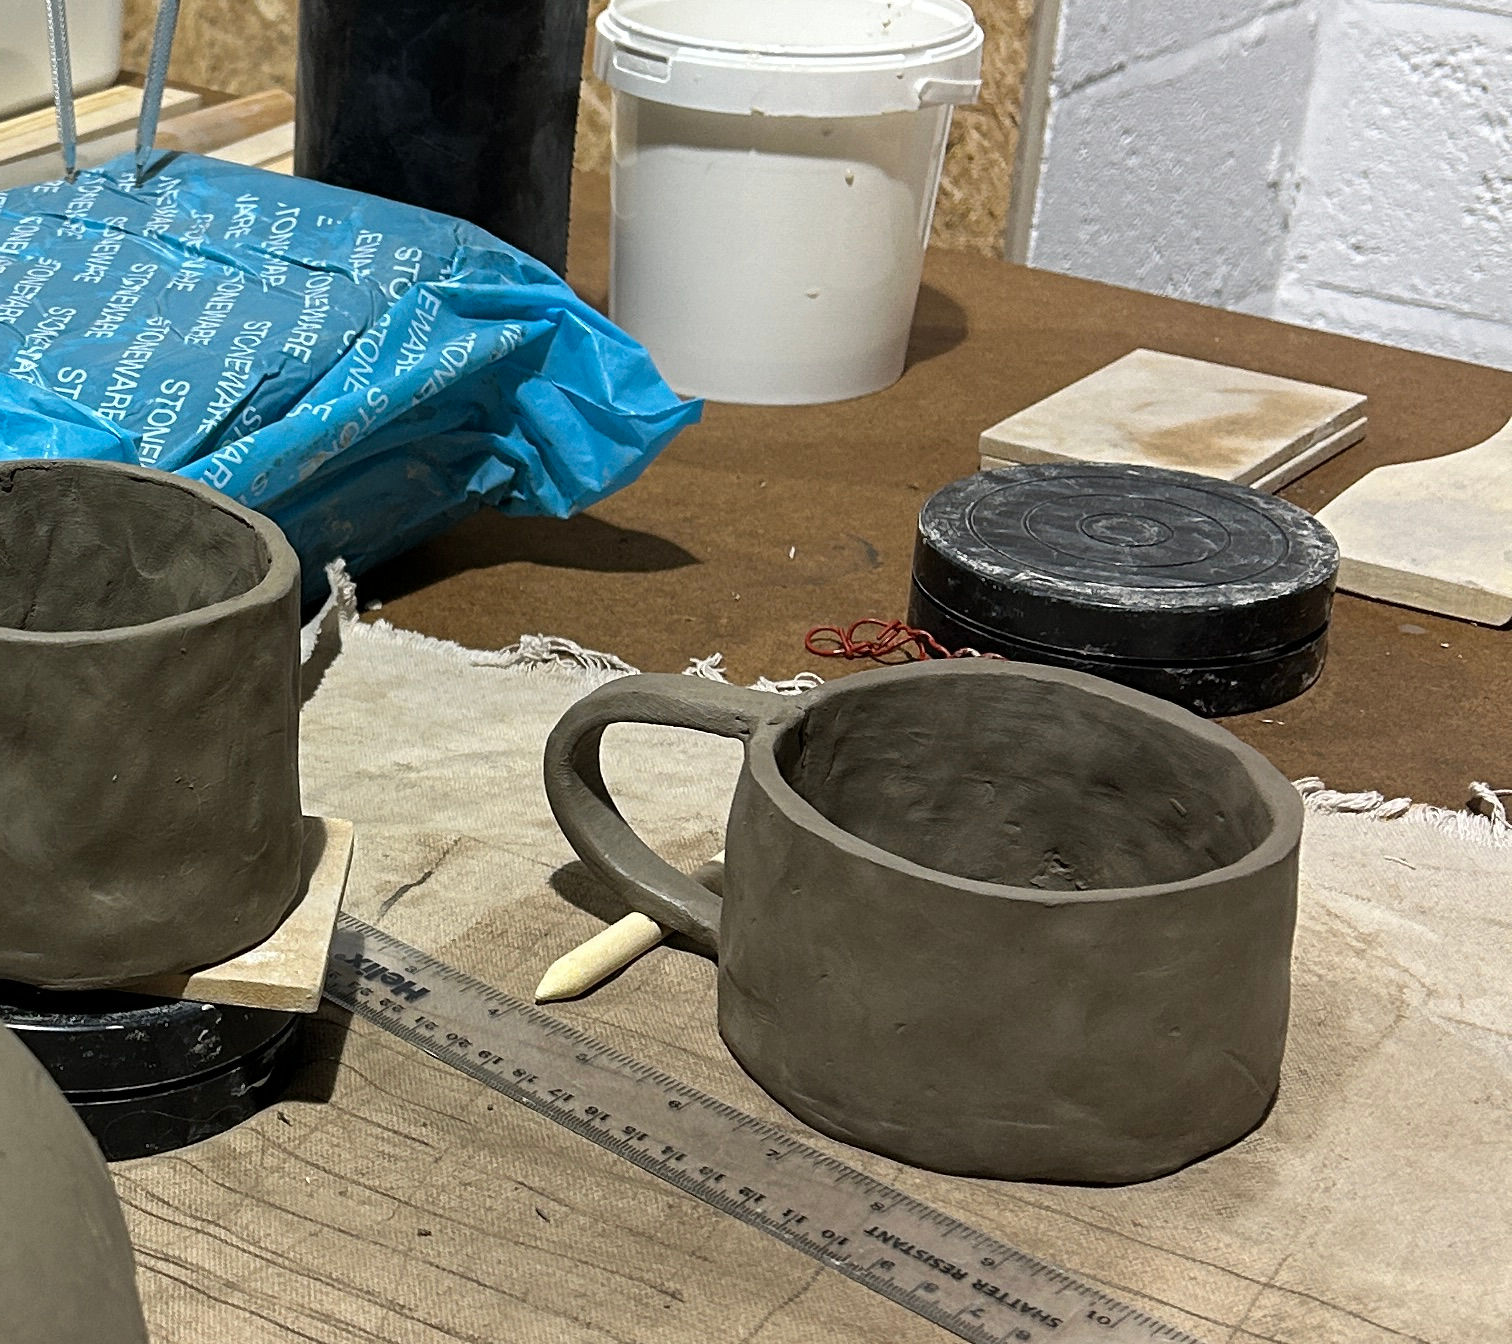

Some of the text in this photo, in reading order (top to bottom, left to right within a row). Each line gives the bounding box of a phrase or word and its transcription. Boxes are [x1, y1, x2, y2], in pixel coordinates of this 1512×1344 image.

[334, 952, 431, 1004] Helix
[863, 1225, 1064, 1329] SHATTER RESISTANT
